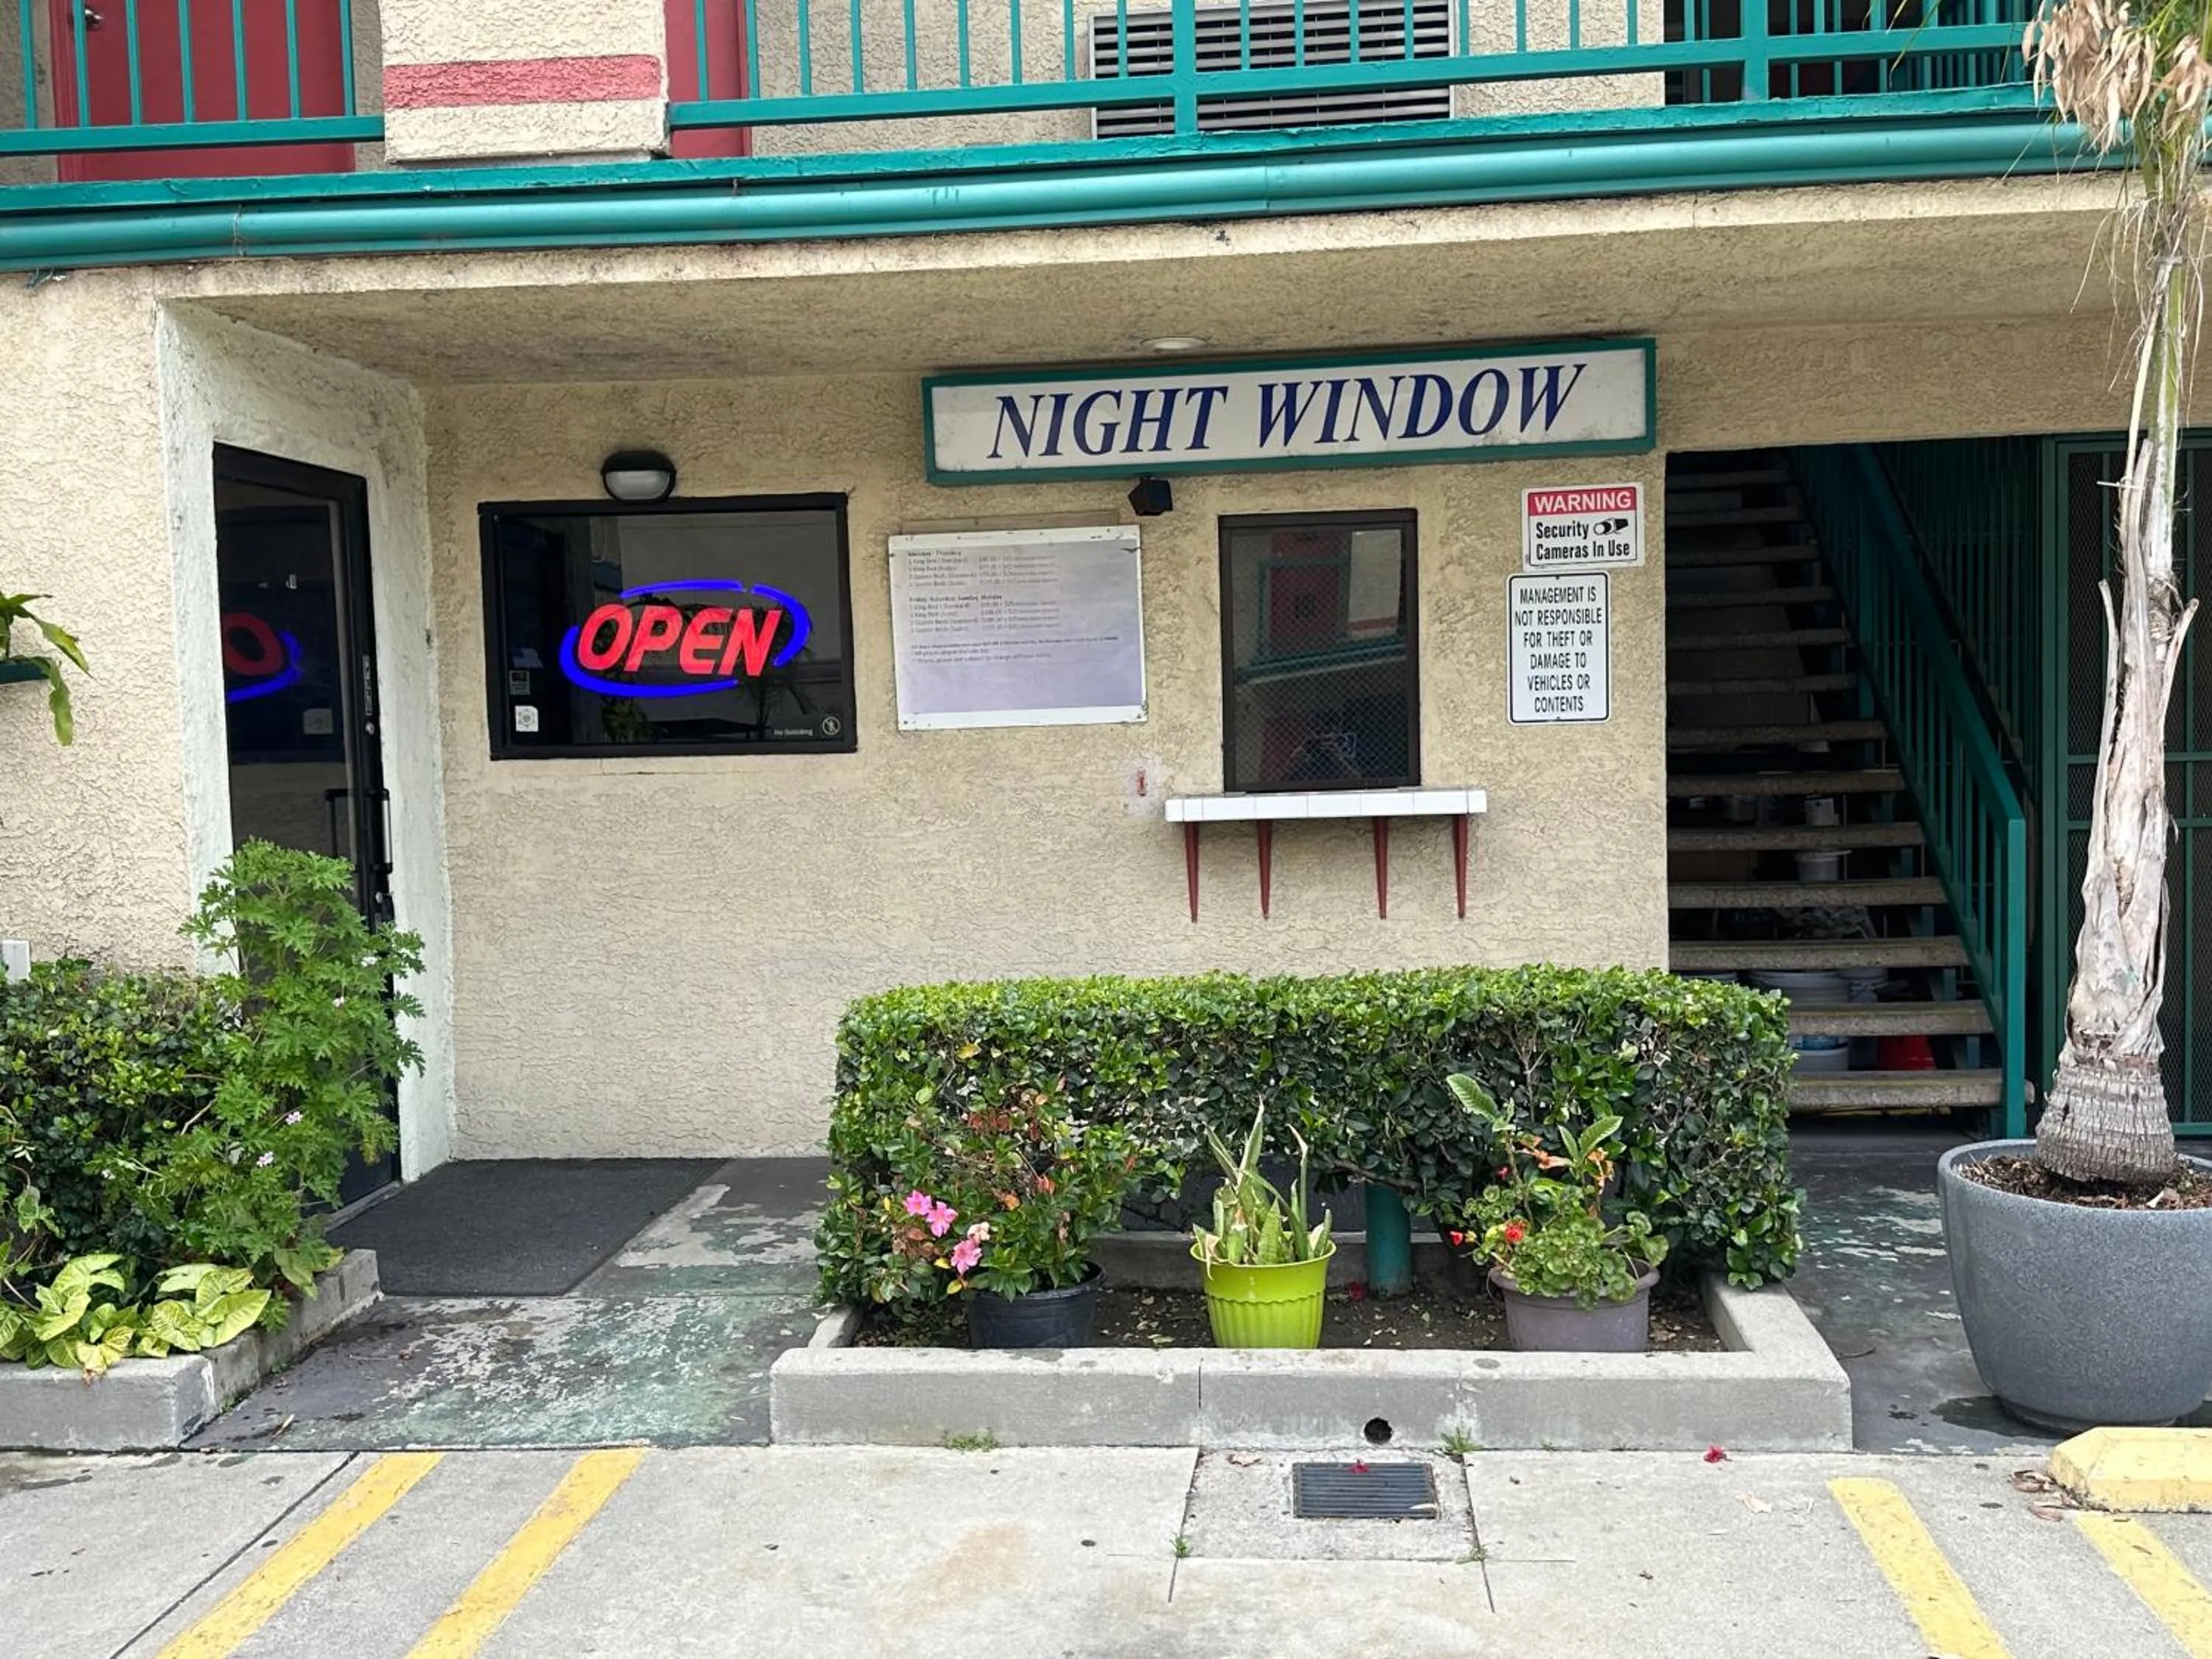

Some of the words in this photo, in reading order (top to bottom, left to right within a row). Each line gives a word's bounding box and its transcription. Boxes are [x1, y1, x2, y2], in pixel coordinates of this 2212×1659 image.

[987, 385, 1228, 459] NIGHT
[1256, 364, 1587, 448] WINDOW
[1534, 491, 1632, 513] WARNING
[1536, 520, 1589, 540] Security
[1536, 542, 1589, 560] Cameras
[1593, 540, 1604, 557] In
[1608, 539, 1630, 557] Use
[1520, 586, 1585, 605] MANAGEMENT
[1587, 586, 1596, 602] IS
[1514, 610, 1534, 626] NOT
[1537, 607, 1602, 625] RESPONSIBLE
[577, 603, 782, 676] OPEN
[1523, 632, 1542, 647] FOR
[1547, 630, 1576, 647] THEFT
[1579, 630, 1593, 647] OR
[1530, 653, 1571, 669] DAMAGE
[1574, 652, 1586, 669] TO
[1527, 675, 1573, 691] VEHICLES
[1577, 674, 1590, 690] OR
[1534, 696, 1584, 713] CONTENTS
